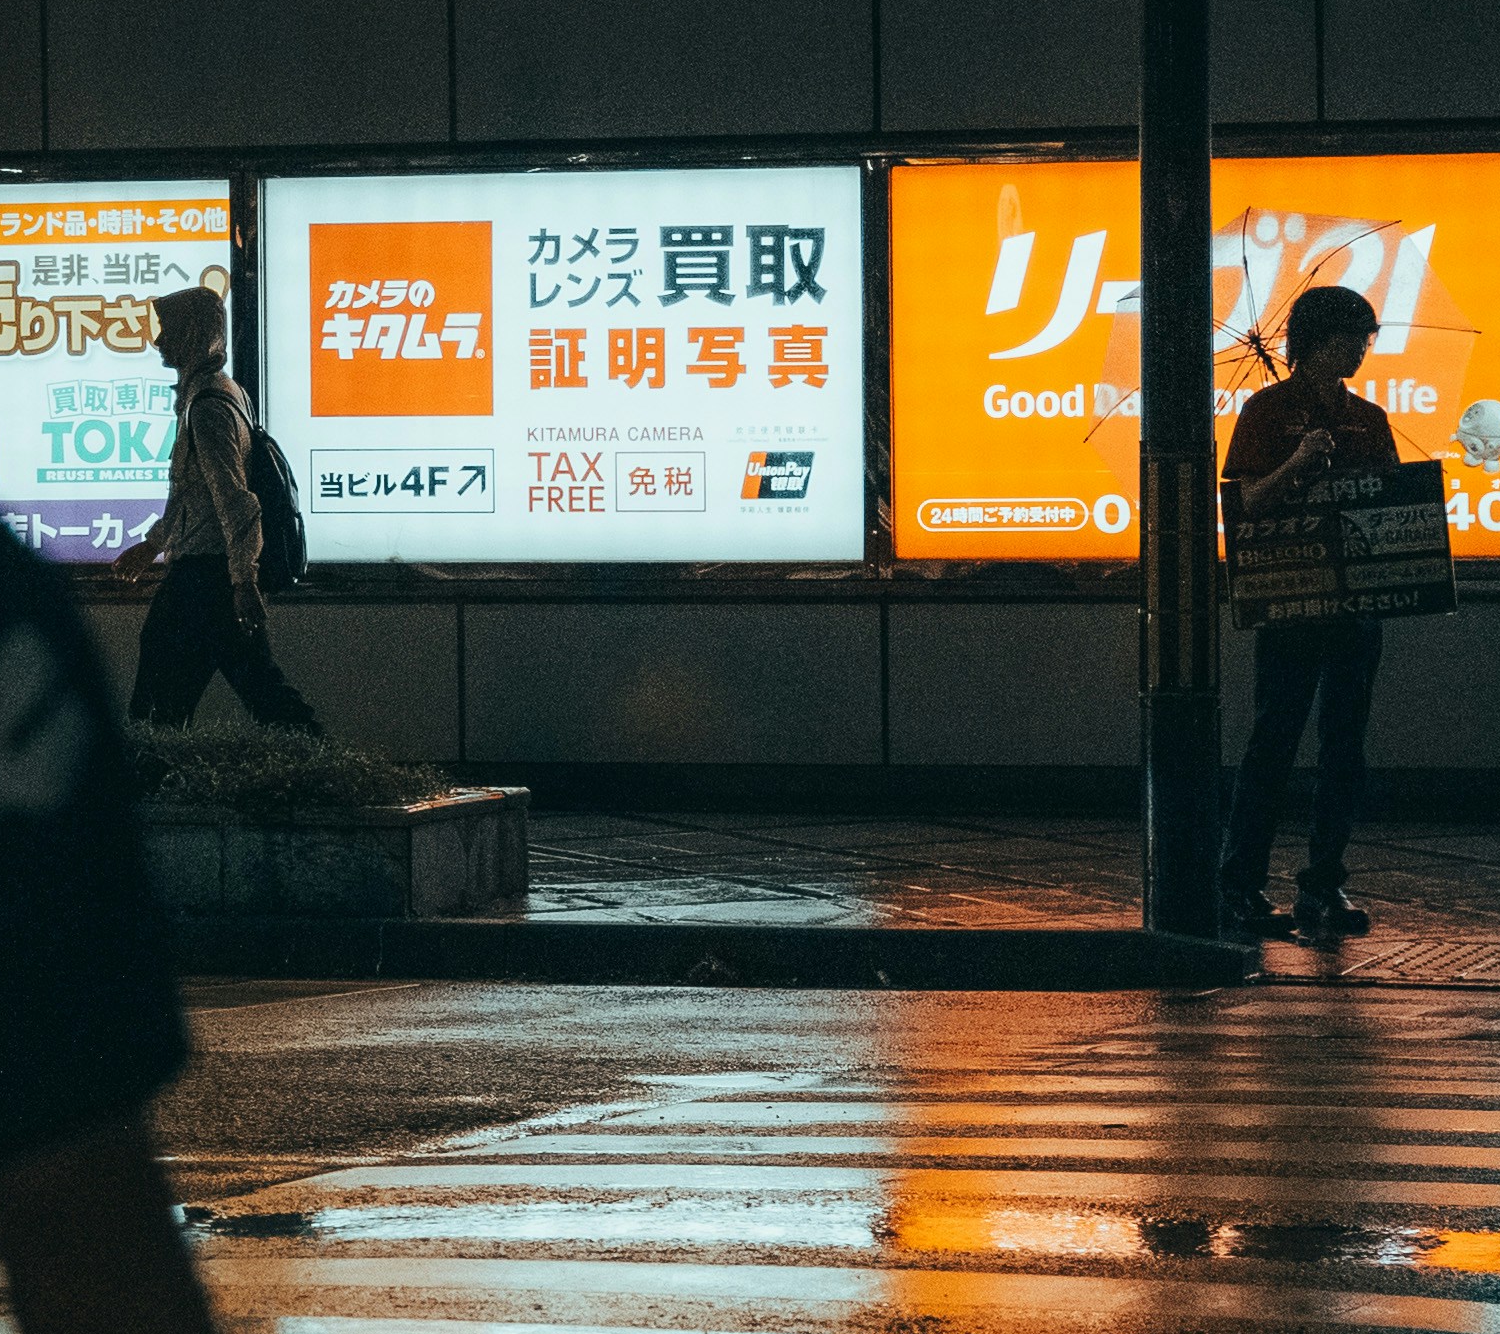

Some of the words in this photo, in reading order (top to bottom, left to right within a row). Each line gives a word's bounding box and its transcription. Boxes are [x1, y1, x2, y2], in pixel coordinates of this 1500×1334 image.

[528, 227, 641, 266] カメラ
[32, 253, 191, 287] 是非、当店へ
[657, 224, 828, 307] 買取
[325, 280, 436, 309] カメラの
[528, 269, 643, 309] レンズ
[527, 324, 830, 390] 証明写真
[983, 384, 1085, 419] Good
[526, 426, 620, 443] KITAMURA
[627, 426, 704, 442] CAMERA
[45, 470, 95, 481] REUSE
[100, 470, 153, 481] MAKES
[527, 451, 604, 482] TAX
[627, 466, 694, 497] 免税
[747, 461, 811, 480] UnionPay
[319, 466, 449, 500] 当ビル4F
[527, 486, 606, 513] FREE
[929, 506, 1076, 525] 24時間ご予約受付中
